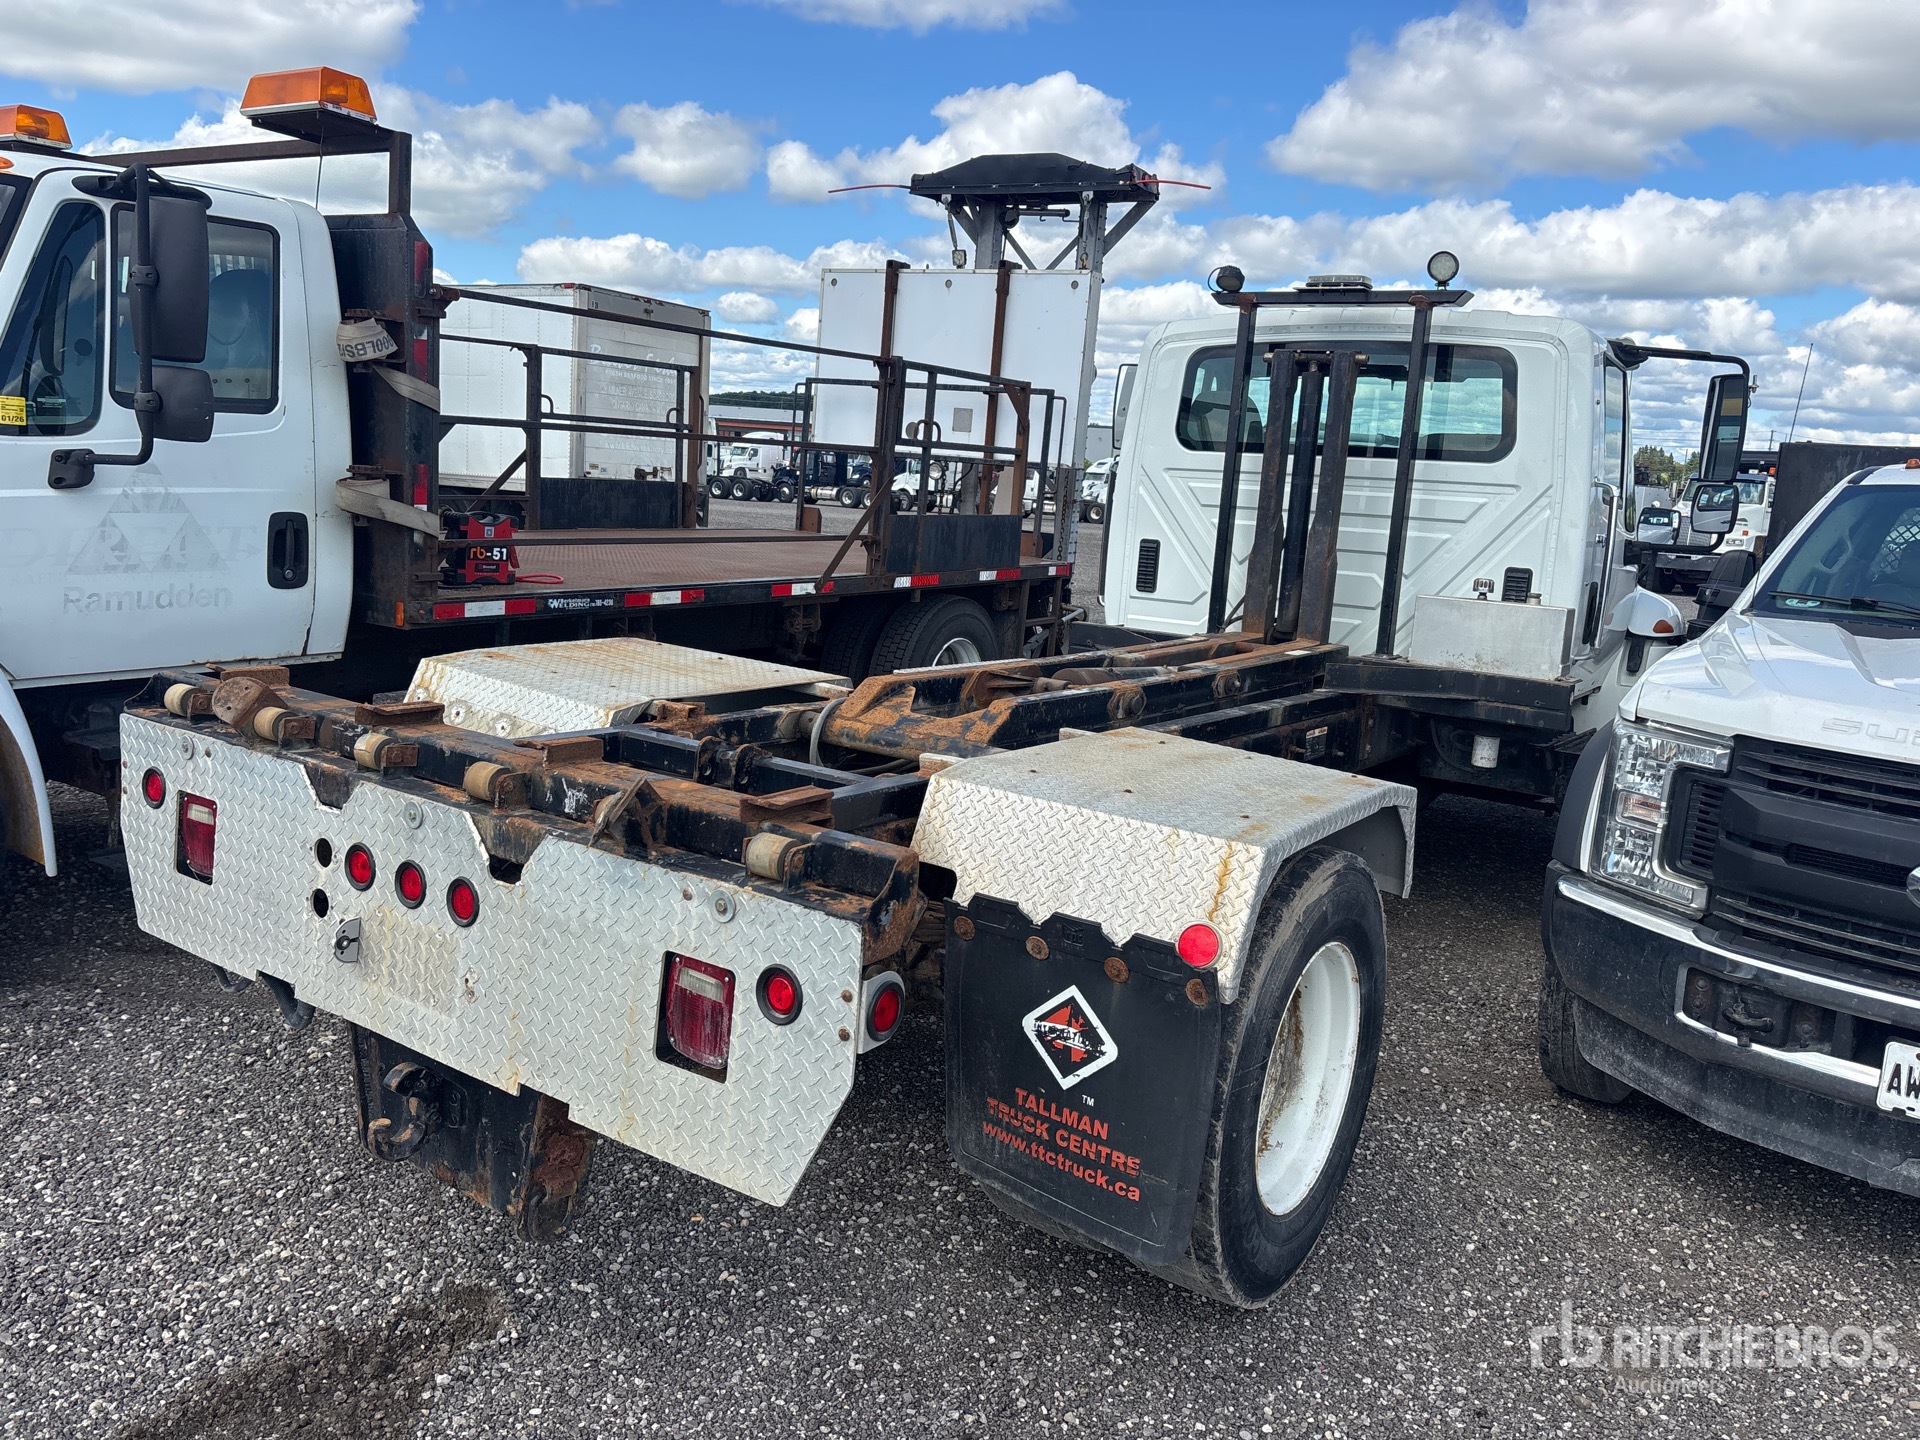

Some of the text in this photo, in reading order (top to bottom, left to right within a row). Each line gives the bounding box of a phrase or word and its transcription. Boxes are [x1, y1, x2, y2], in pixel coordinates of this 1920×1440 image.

[1, 414, 25, 423] 01/26
[470, 546, 507, 560] rb-51
[63, 582, 233, 614] Ramudden
[1015, 1087, 1109, 1141] TALLMAN
[1081, 1094, 1095, 1107] TM
[986, 1096, 1142, 1177] TRUCK CENTRE
[982, 1120, 1141, 1202] www.ttctruck.ca
